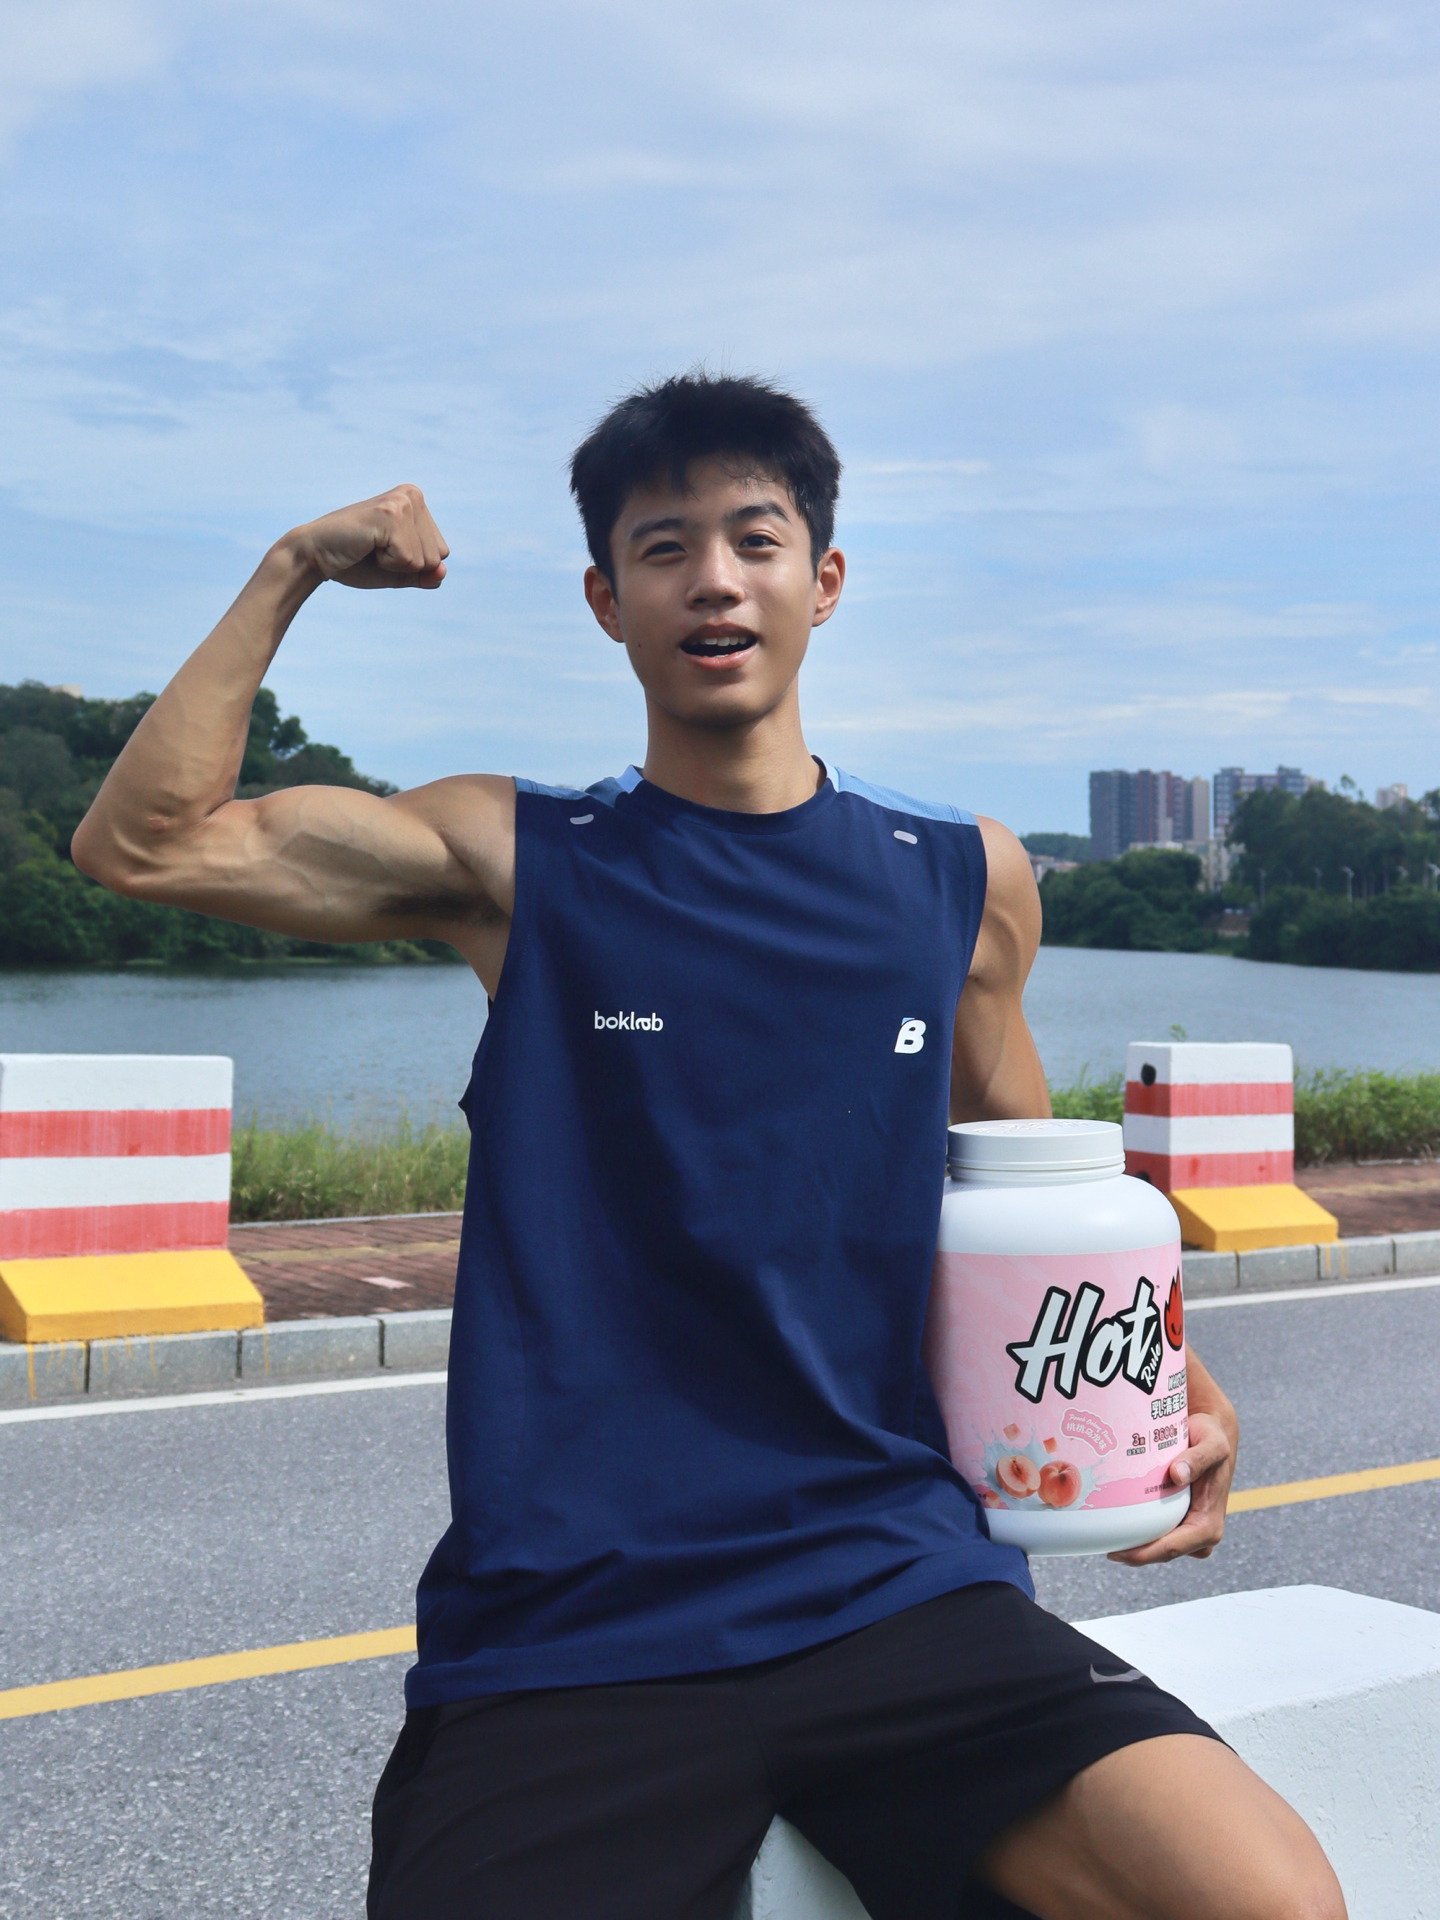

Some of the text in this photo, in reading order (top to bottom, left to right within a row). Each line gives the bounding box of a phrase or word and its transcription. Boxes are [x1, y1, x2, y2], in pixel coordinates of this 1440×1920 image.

[593, 1010, 664, 1032] boklab
[893, 1018, 926, 1053] B
[1007, 1277, 1160, 1403] Hot
[1141, 1342, 1161, 1387] Rule
[1151, 1388, 1187, 1420] 乳清蛋白
[1066, 1421, 1107, 1450] 桃桃乌龙味
